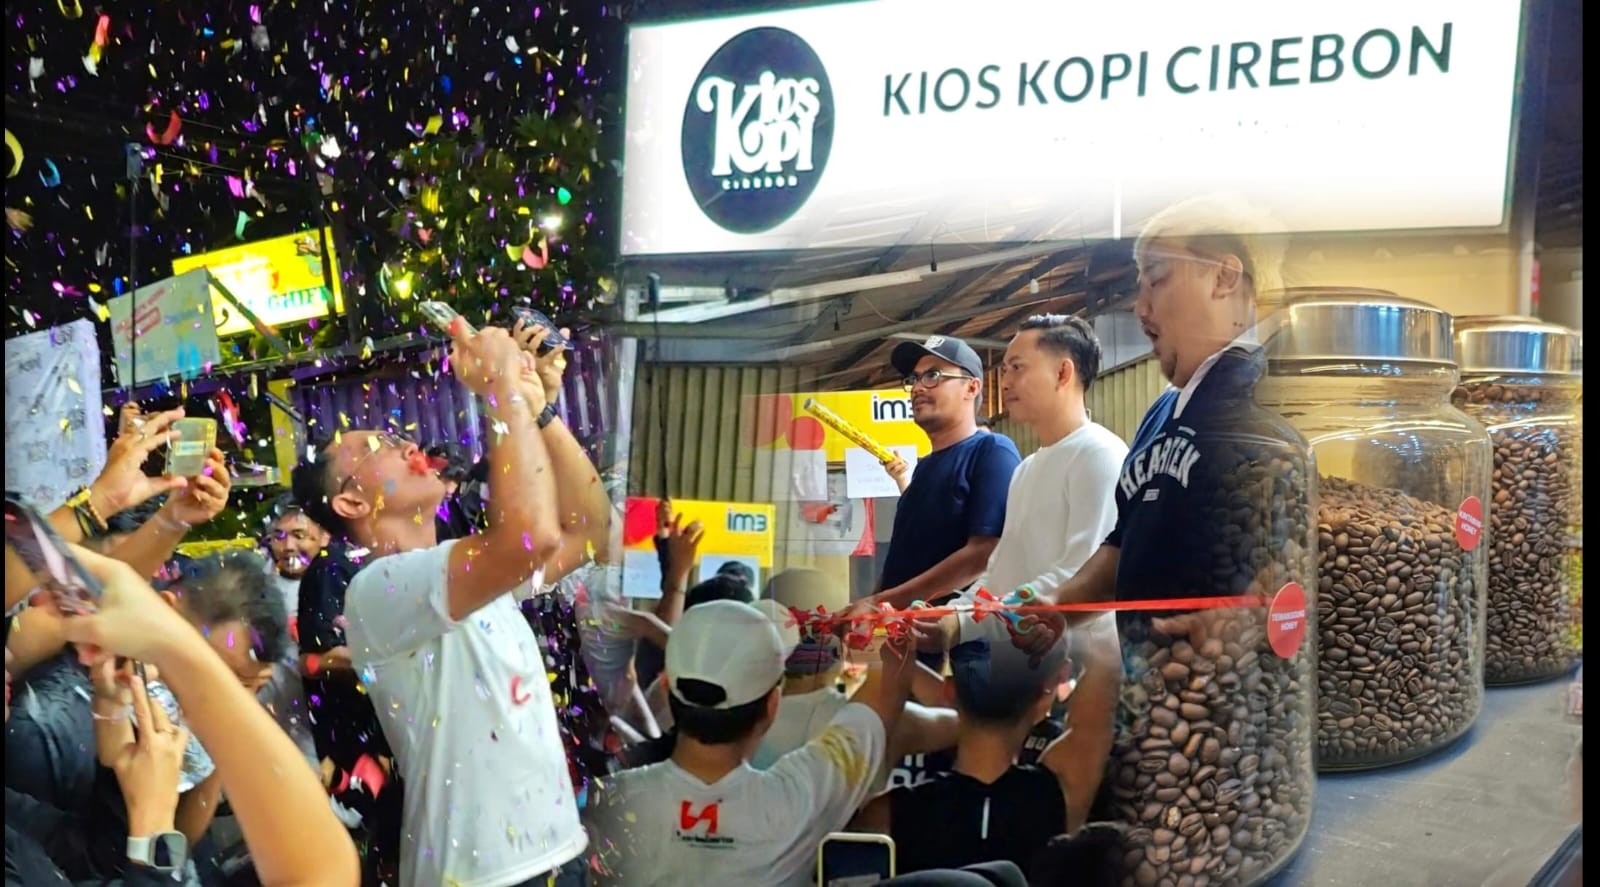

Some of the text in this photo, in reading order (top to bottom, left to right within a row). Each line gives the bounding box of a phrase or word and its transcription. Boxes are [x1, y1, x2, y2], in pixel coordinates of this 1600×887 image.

[883, 22, 1453, 116] KIOS KOPI CIREBON
[727, 508, 767, 532] im3
